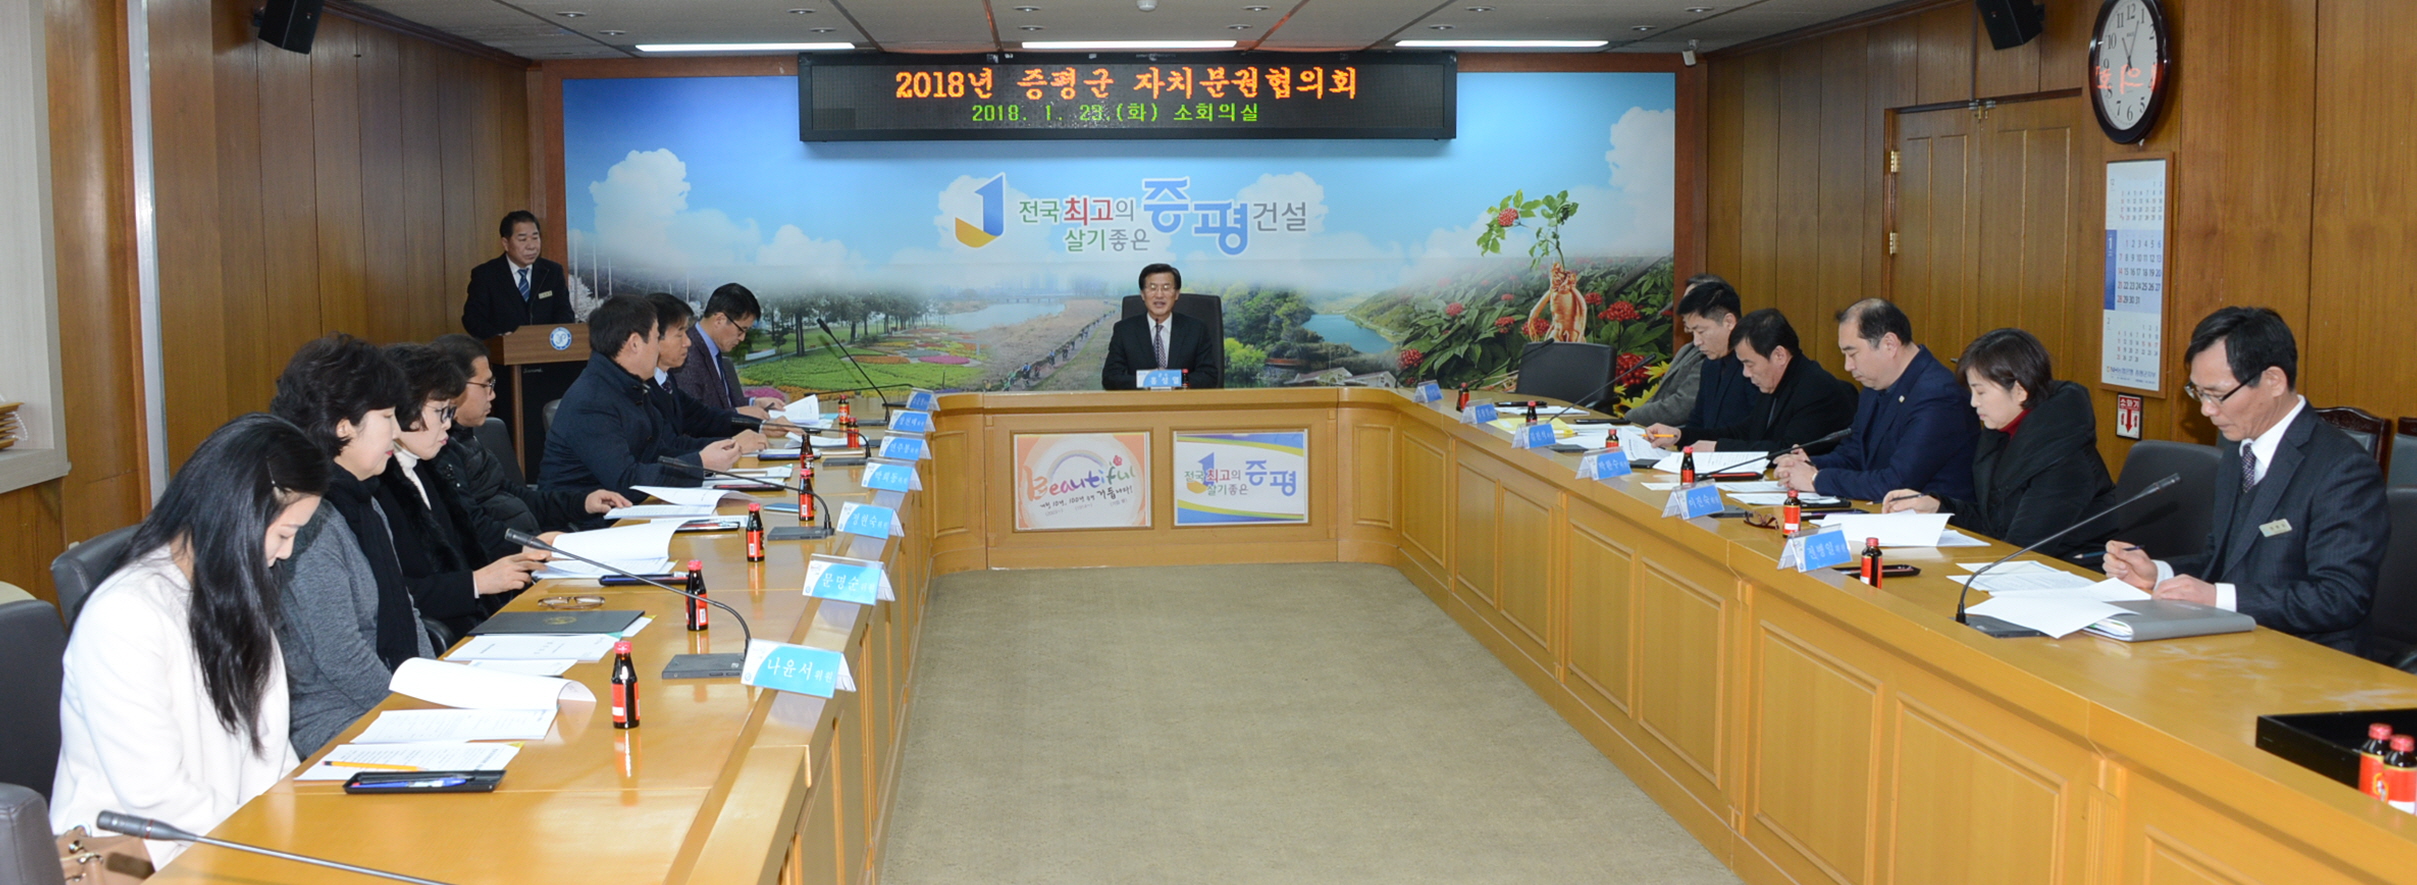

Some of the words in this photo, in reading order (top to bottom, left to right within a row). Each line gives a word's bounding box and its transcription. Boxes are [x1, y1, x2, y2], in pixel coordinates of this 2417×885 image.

[2116, 13, 2124, 29] 11
[2127, 4, 2136, 21] 12
[2107, 35, 2117, 50] 10
[896, 67, 993, 99] 2018년
[1016, 67, 1114, 100] 증평군
[1132, 66, 1356, 100] 자치분권협의회
[972, 104, 1027, 121] 2018.
[1173, 103, 1258, 122] 소회의실
[2127, 105, 2133, 121] 6
[1019, 199, 1060, 223] 전국
[1063, 197, 1135, 226] 최고의
[1143, 177, 1249, 256] 증평
[1253, 202, 1307, 232] 건설
[1064, 230, 1106, 252] 살기
[1108, 229, 1151, 252] 좋은
[1023, 463, 1136, 502] Beautiful
[1184, 470, 1204, 482] 전국
[1206, 469, 1242, 483] 최고의
[1245, 460, 1297, 497] 증평
[767, 656, 813, 681] 나윤서
[815, 669, 834, 684] 위원
